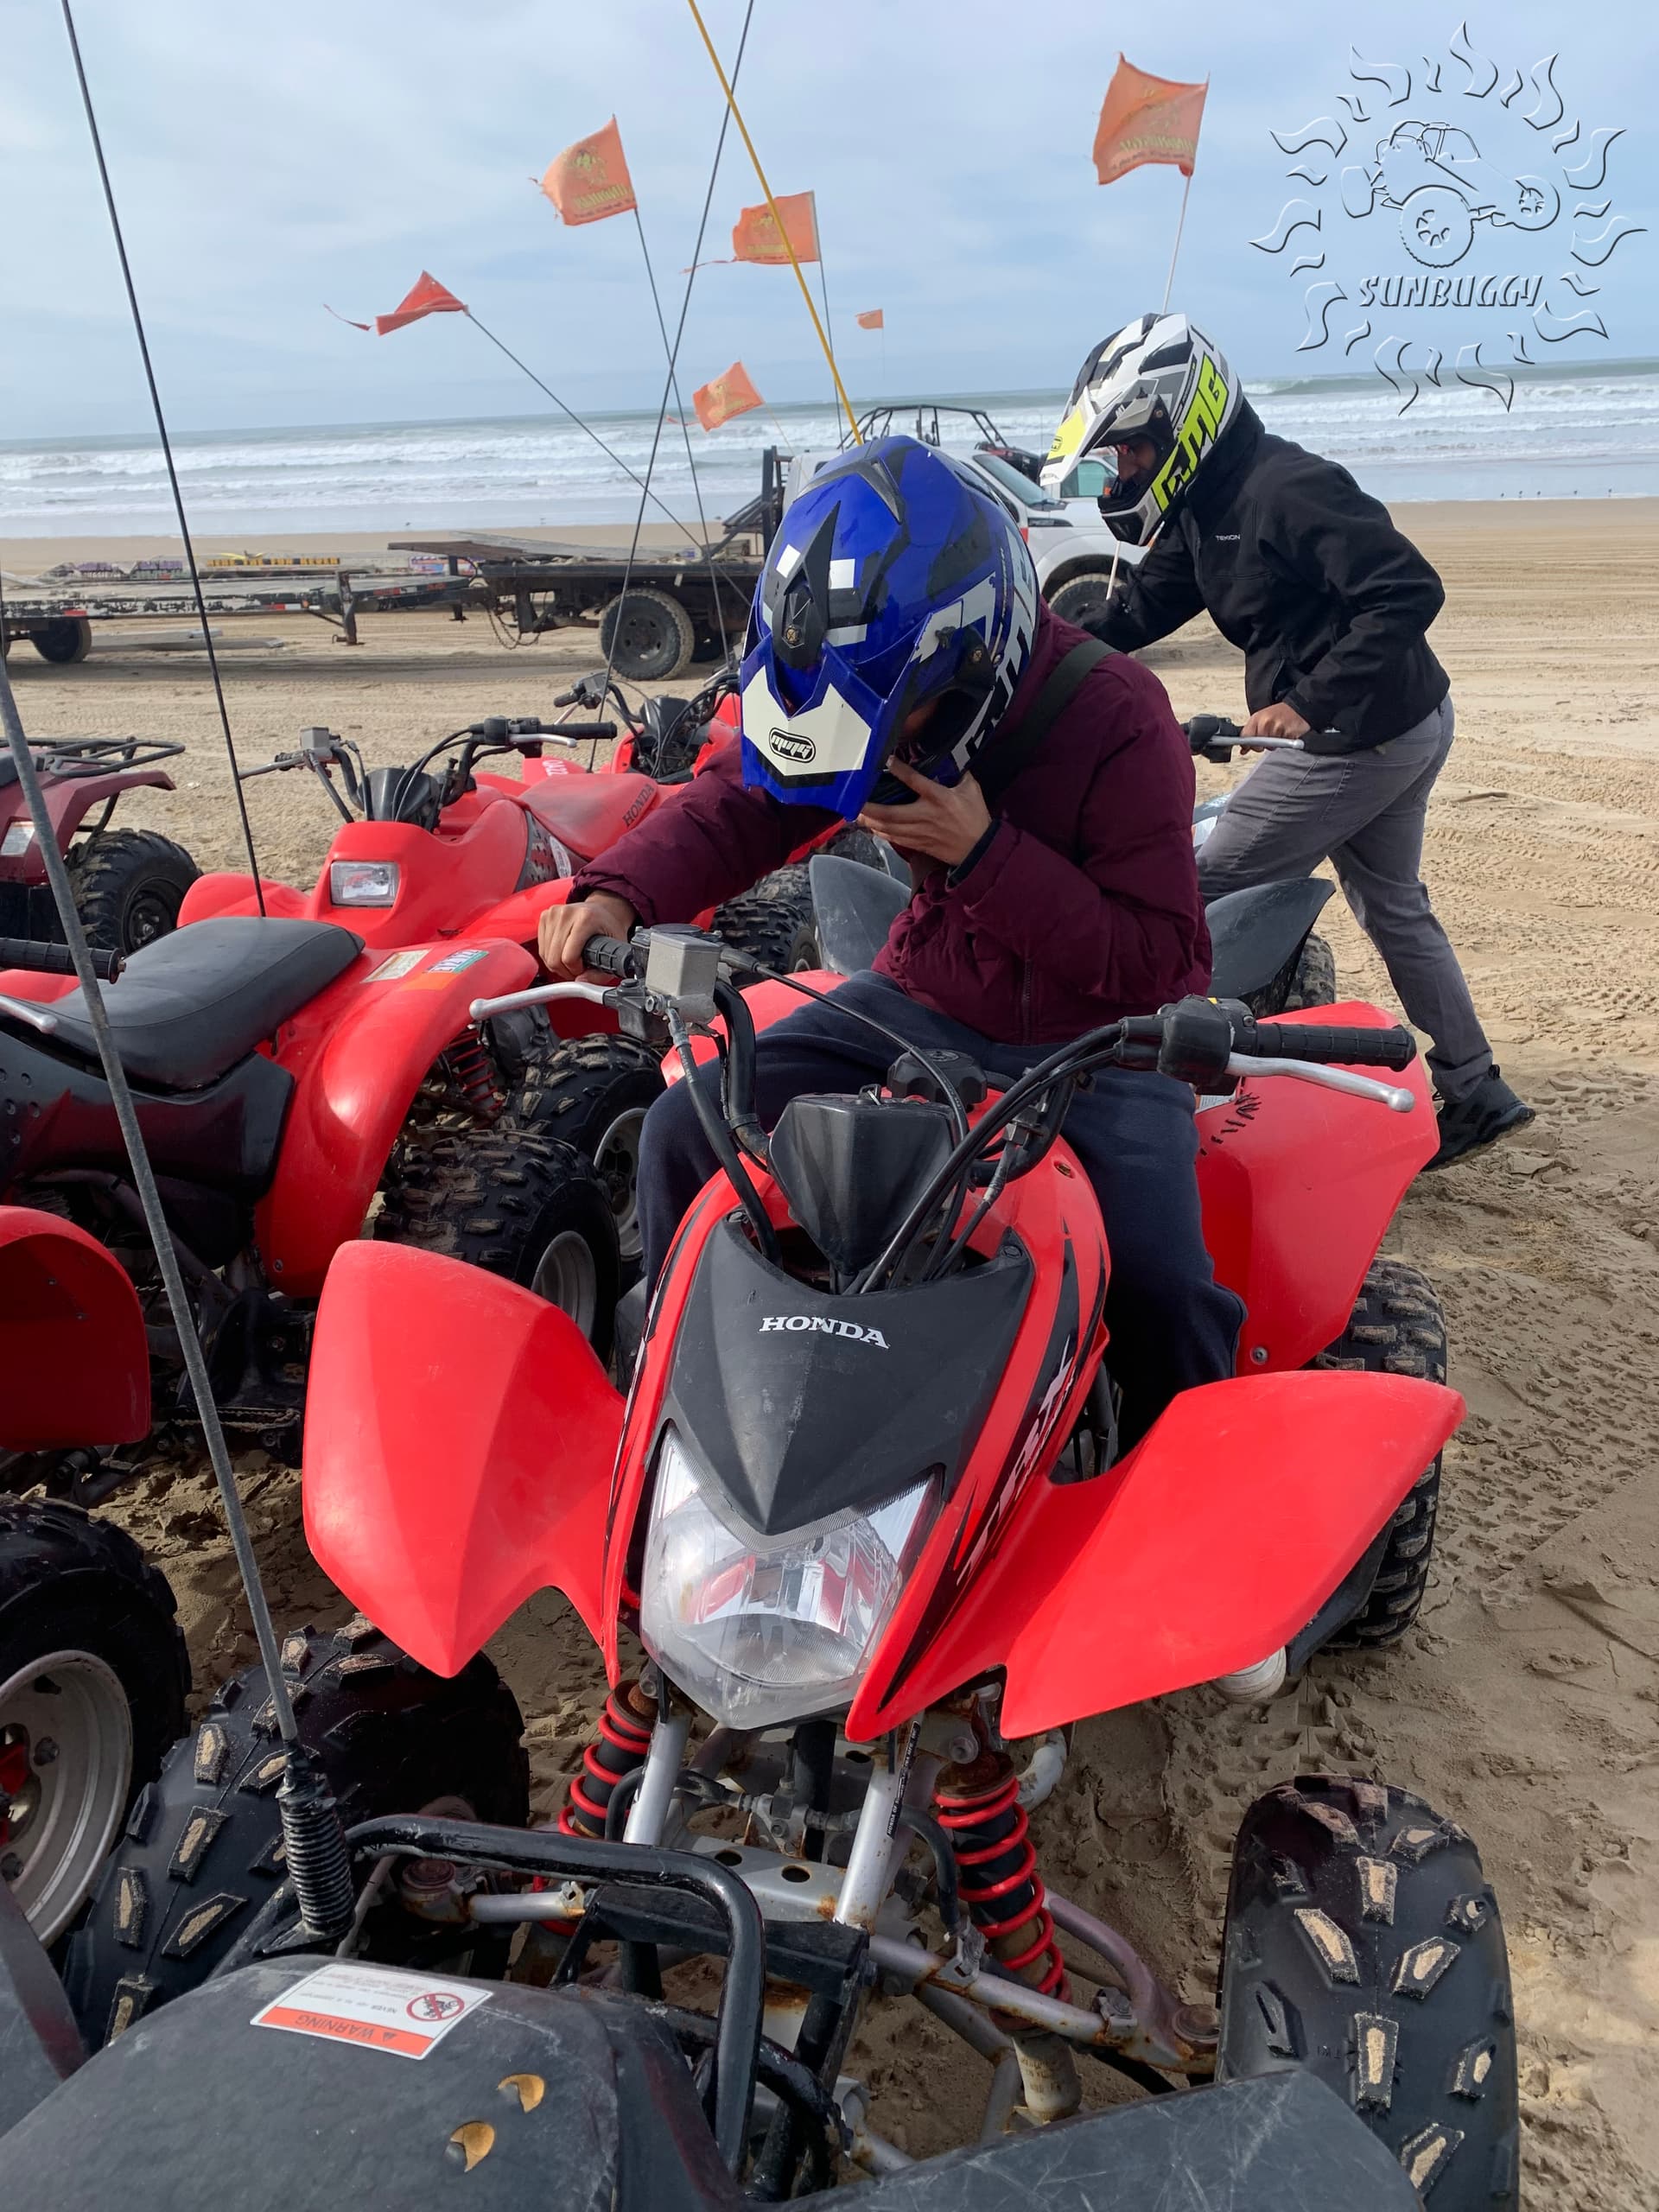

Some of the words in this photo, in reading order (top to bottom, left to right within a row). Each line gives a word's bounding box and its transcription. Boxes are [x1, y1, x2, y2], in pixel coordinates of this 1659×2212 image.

[623, 783, 655, 827] HONDA
[759, 1315, 890, 1350] HONDA
[295, 2013, 375, 2039] WARNING
